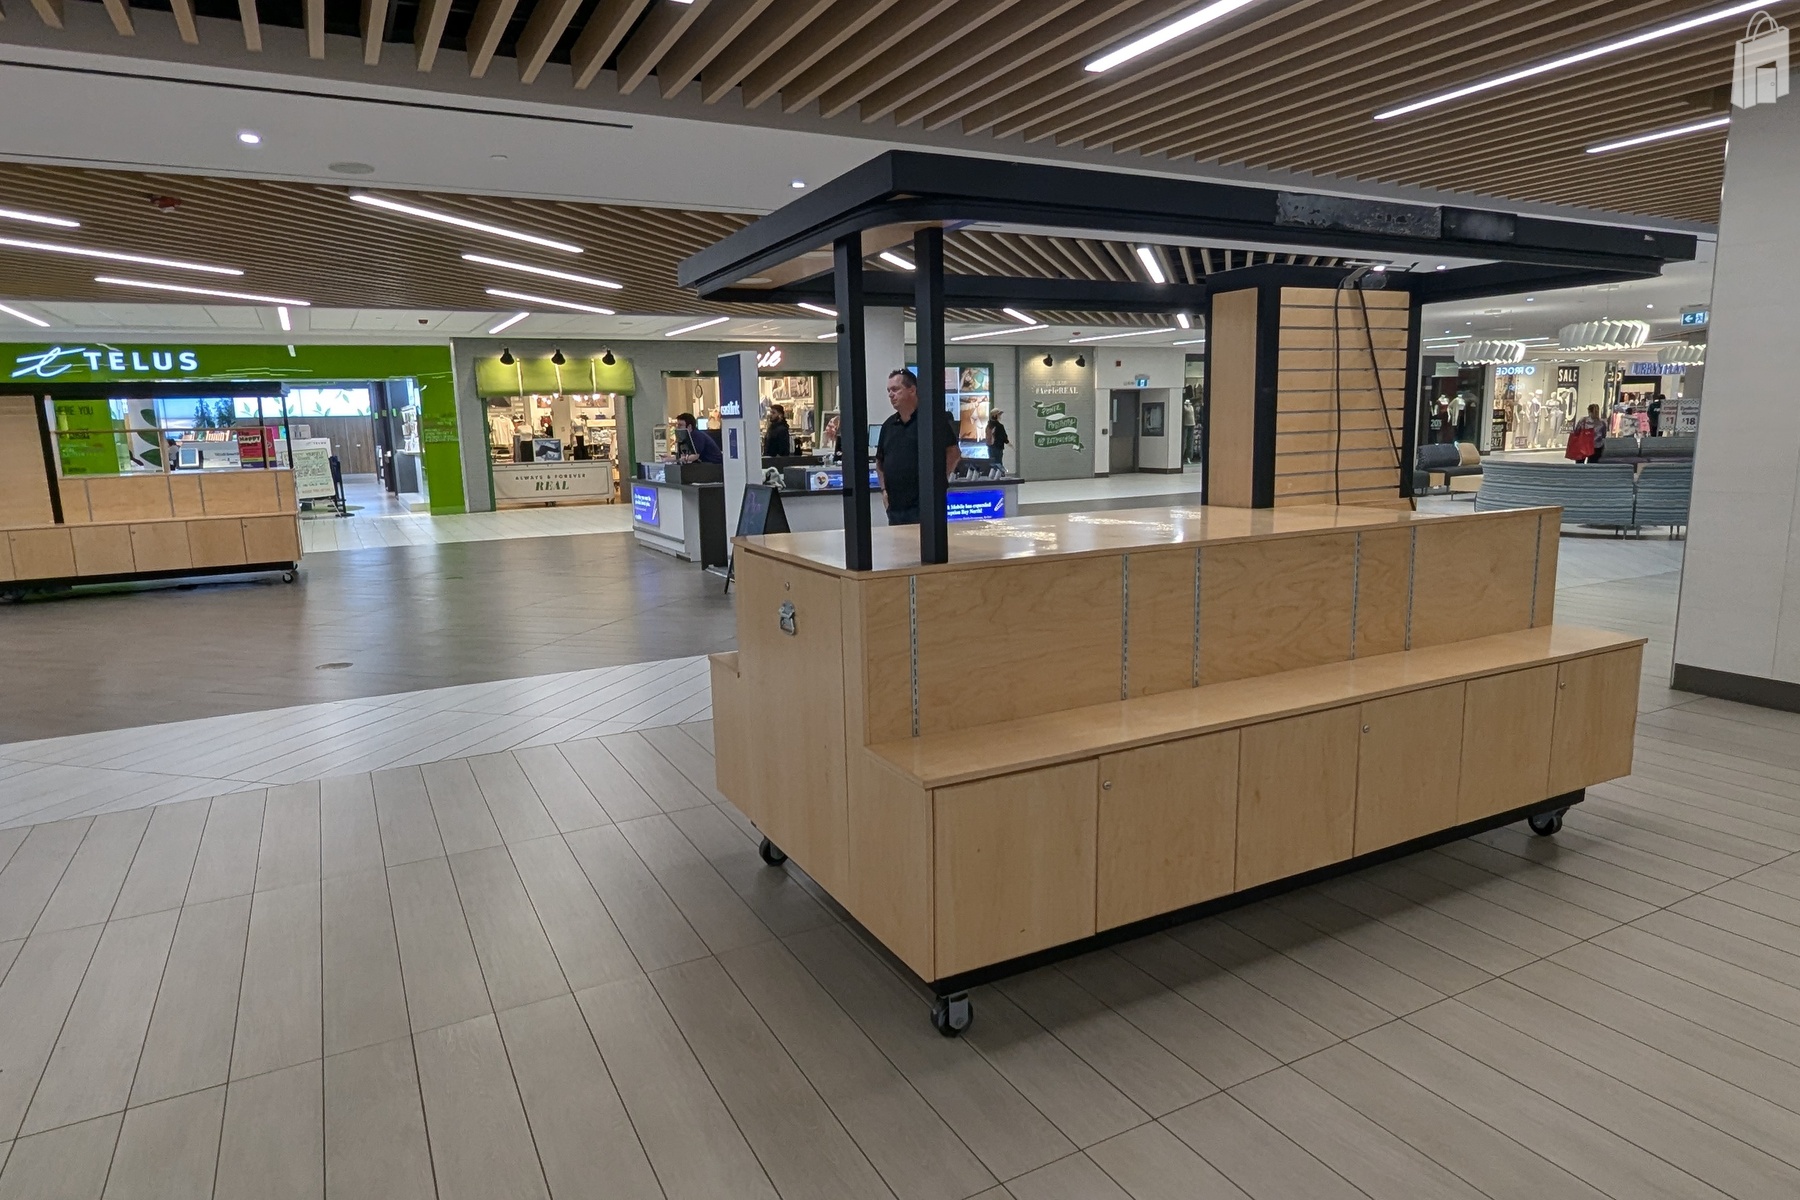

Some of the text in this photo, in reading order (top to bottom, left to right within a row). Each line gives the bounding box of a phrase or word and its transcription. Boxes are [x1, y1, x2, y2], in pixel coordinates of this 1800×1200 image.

[83, 351, 198, 371] TELUS
[1558, 369, 1578, 382] SALE
[78, 406, 93, 415] YOU
[1682, 417, 1695, 425] $18
[535, 481, 569, 491] REAL
